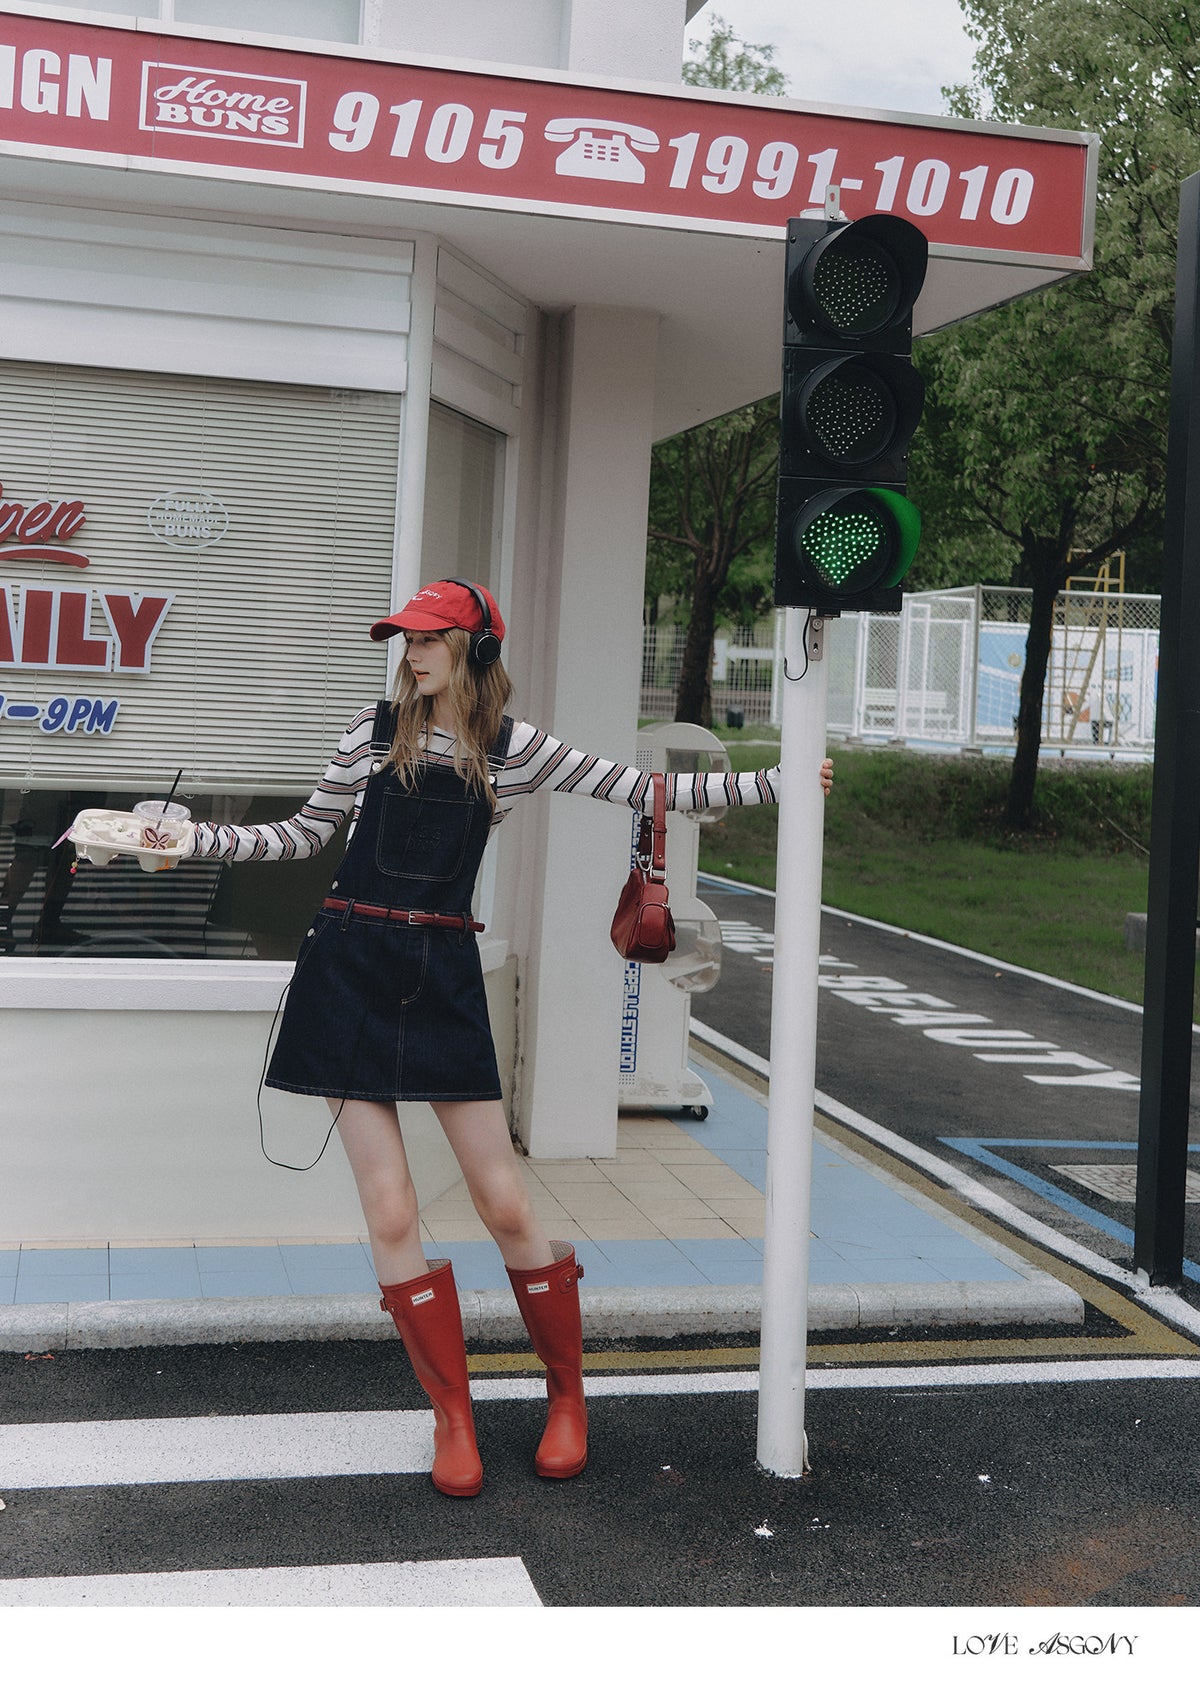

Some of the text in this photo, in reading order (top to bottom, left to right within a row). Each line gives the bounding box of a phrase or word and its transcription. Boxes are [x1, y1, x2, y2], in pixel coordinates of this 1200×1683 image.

[154, 76, 294, 115] Home
[155, 103, 290, 136] BUNS
[328, 91, 1035, 226] 9105 1991-1010
[164, 500, 213, 514] FULLY
[164, 523, 212, 539] BUNS
[818, 974, 1141, 1091] BEAUTY
[412, 1292, 433, 1303] HUNTER
[528, 1284, 549, 1292] HUNTER
